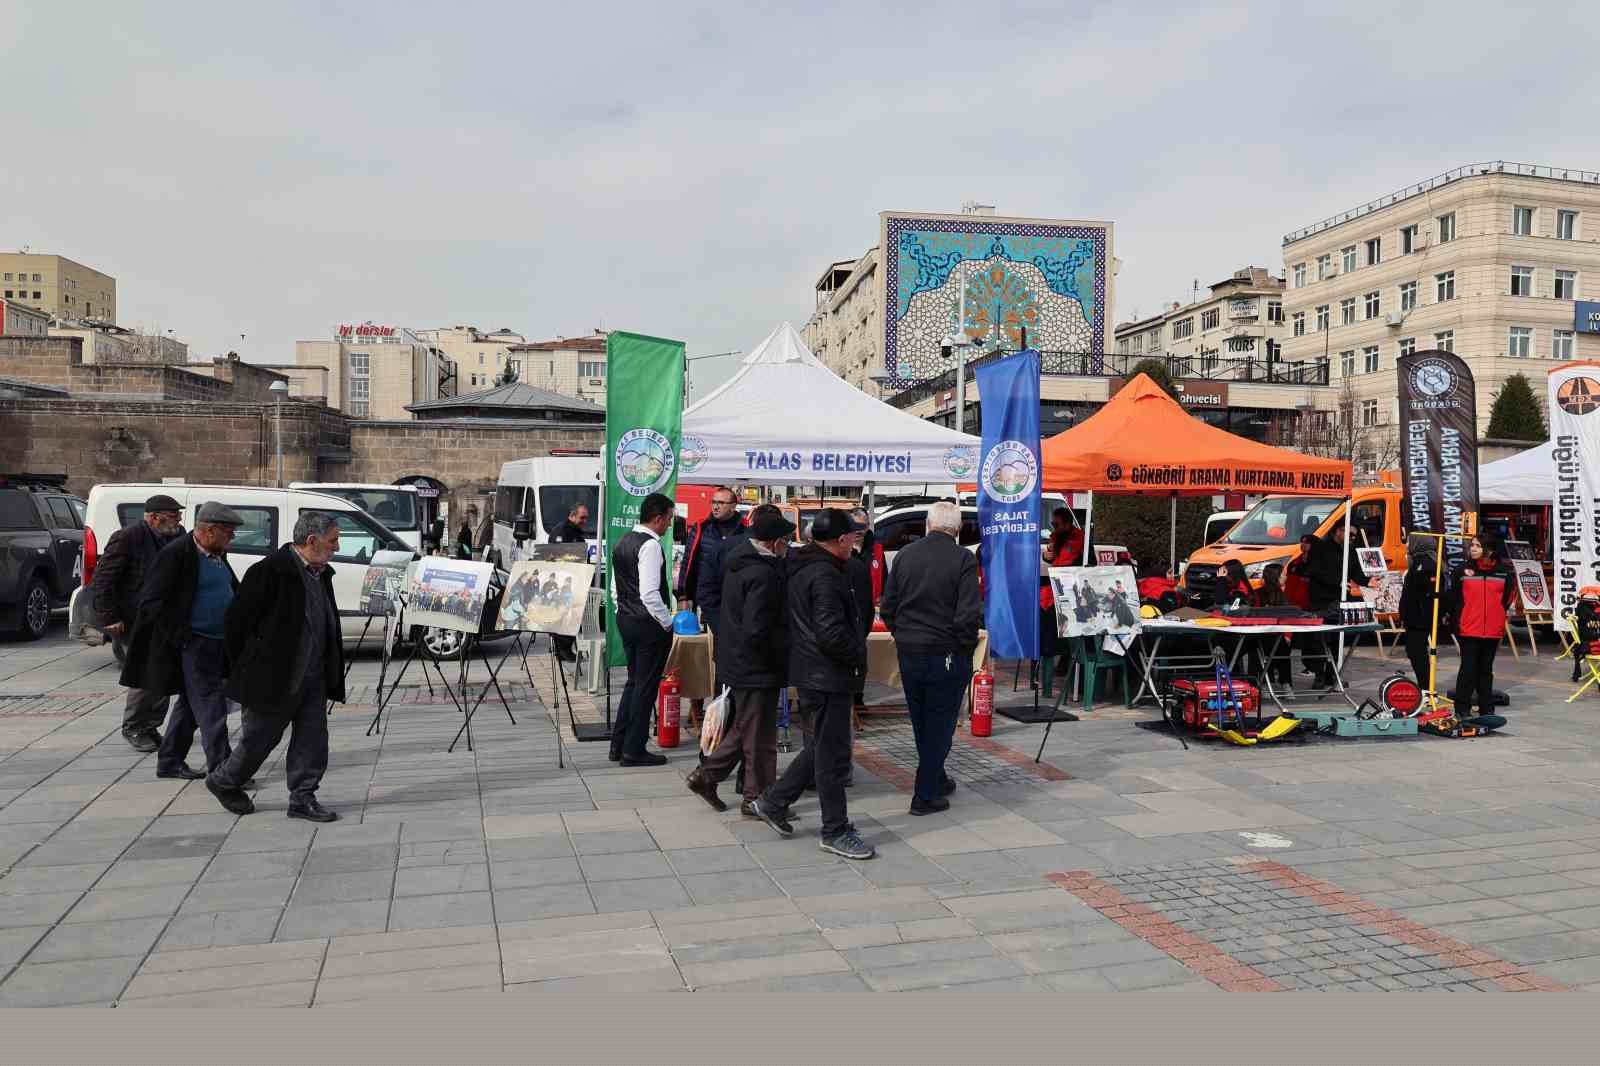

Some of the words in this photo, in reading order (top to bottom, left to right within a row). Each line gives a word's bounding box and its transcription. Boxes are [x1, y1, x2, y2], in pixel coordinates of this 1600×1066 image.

[356, 322, 395, 336] dersler
[1228, 339, 1255, 352] KURS
[1180, 394, 1221, 404] ahvecisi
[745, 451, 801, 471] TALAS
[812, 450, 911, 473] BELEDİYESİ
[1132, 463, 1185, 485] GÖKBÖRÜ
[1189, 468, 1230, 486] ARAMA
[1235, 470, 1297, 489] KURTARMA,
[1301, 471, 1344, 490] KAYSERİ
[623, 504, 641, 515] TAL
[1101, 551, 1113, 561] 112
